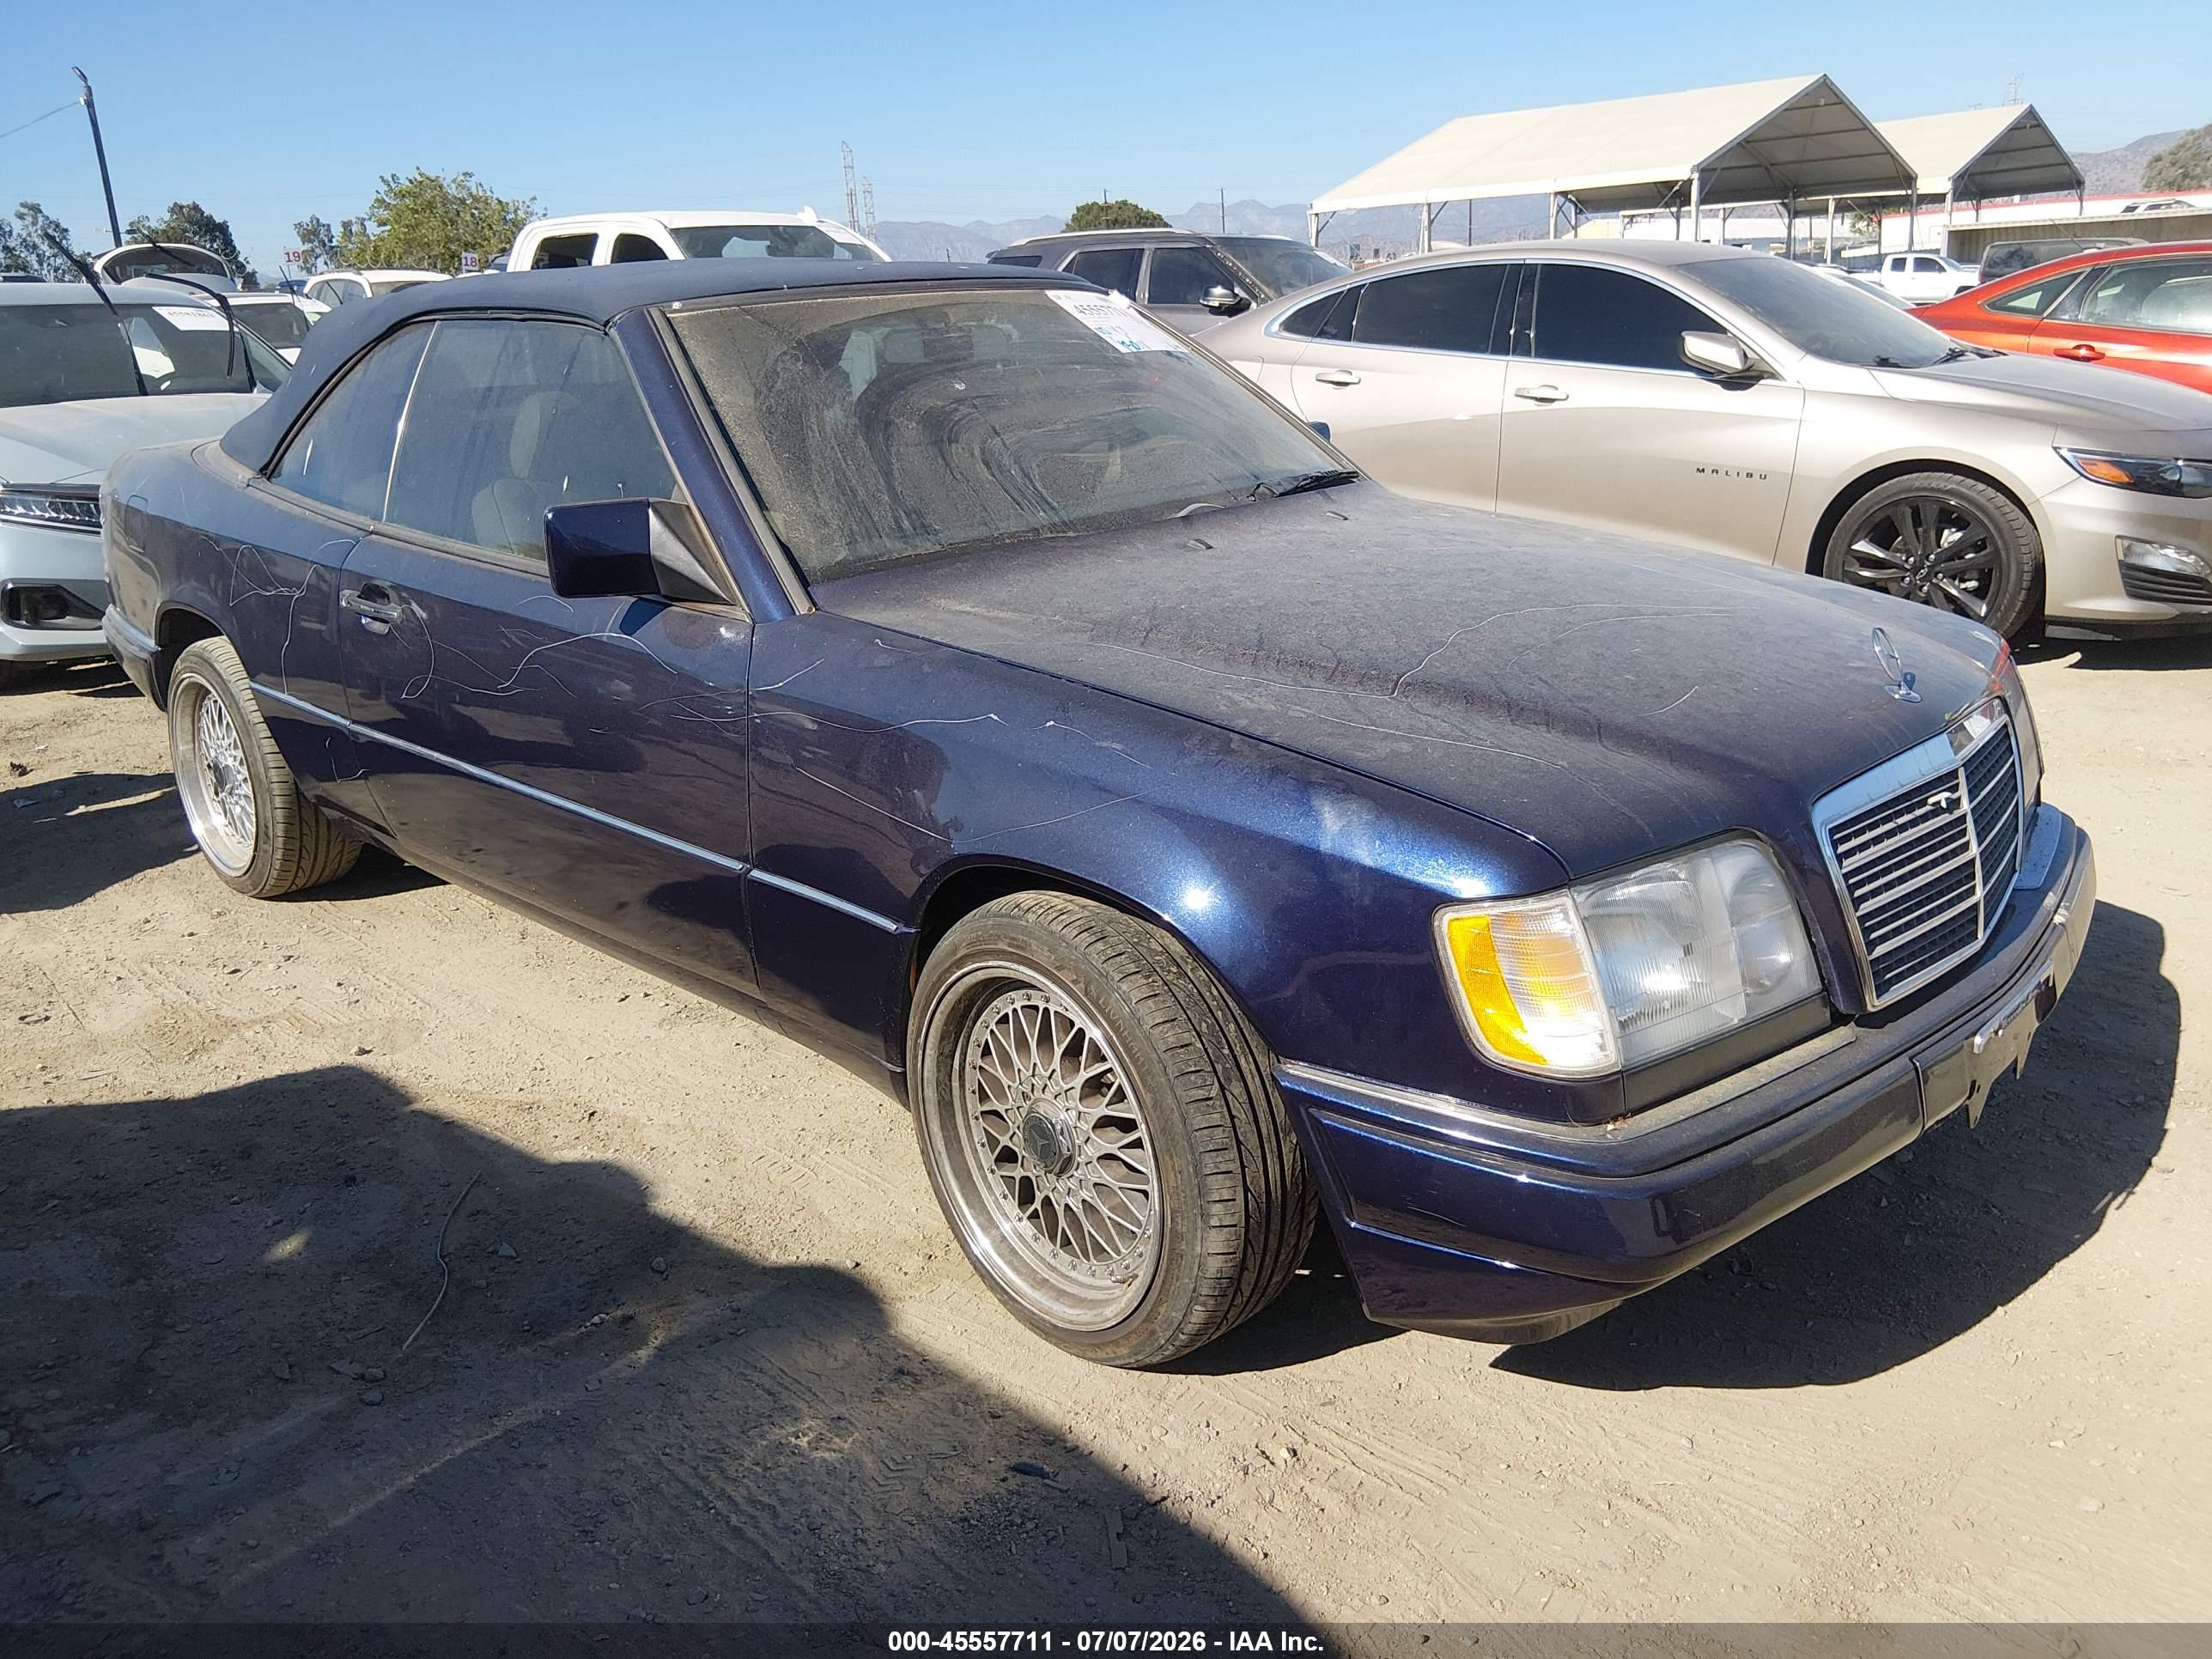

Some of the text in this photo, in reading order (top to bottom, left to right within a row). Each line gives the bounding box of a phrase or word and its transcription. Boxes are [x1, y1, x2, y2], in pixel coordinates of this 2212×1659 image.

[284, 251, 301, 262] 19
[464, 256, 477, 267] 18
[1696, 467, 1767, 480] MALIBU
